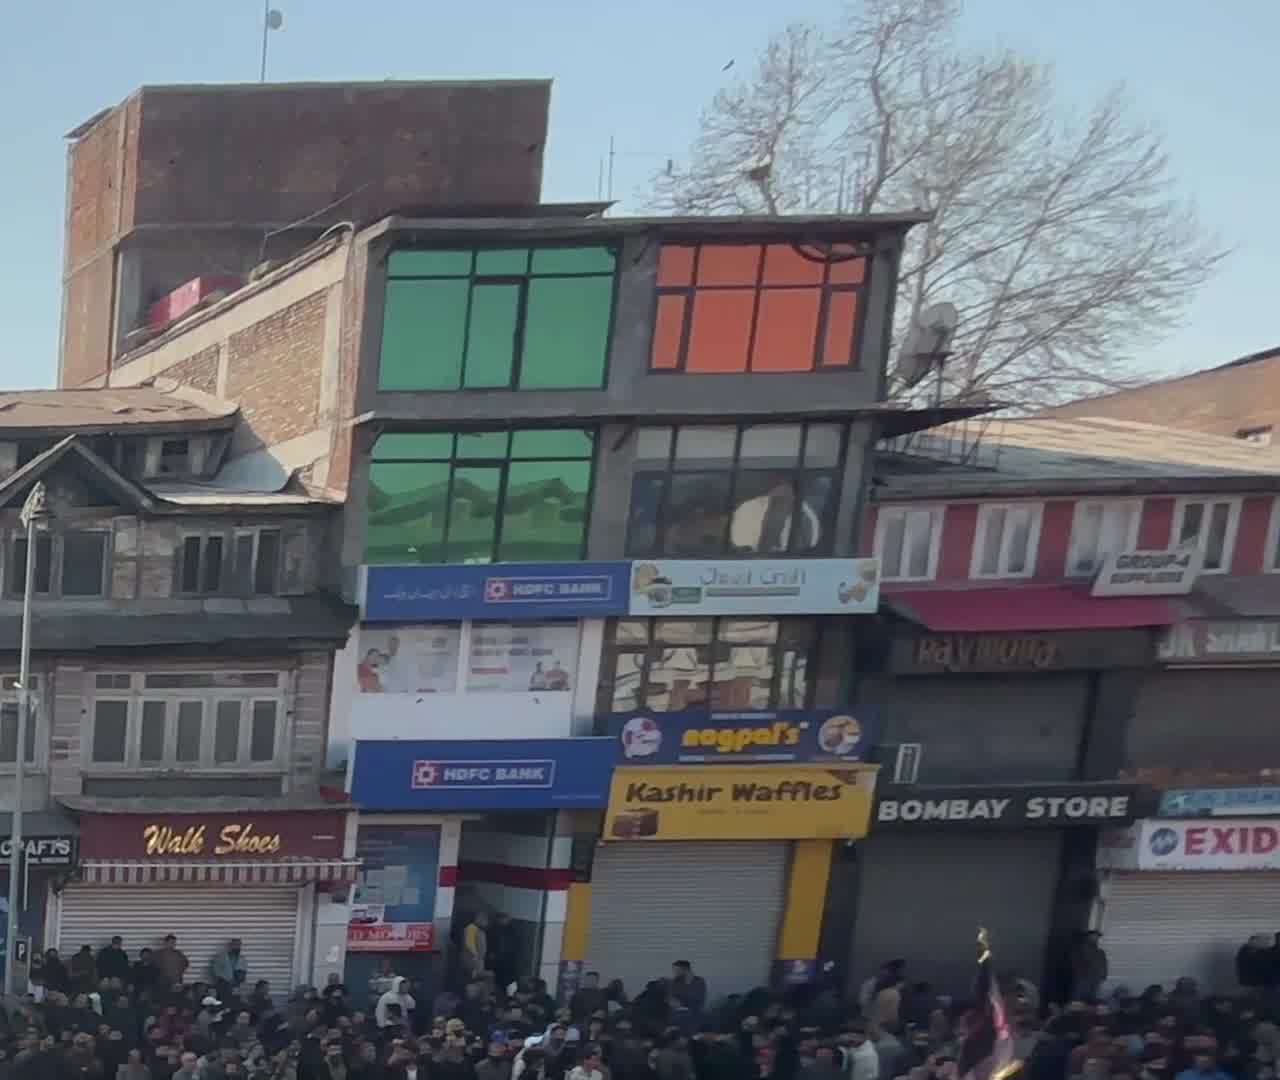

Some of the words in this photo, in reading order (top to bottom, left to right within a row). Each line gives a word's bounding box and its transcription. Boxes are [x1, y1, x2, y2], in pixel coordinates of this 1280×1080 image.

[513, 583, 554, 596] HDFC
[559, 582, 601, 595] BANK
[443, 767, 490, 781] HDFC
[495, 767, 545, 780] BANK
[625, 782, 724, 803] Kashir
[731, 780, 844, 802] Waffles
[877, 797, 1012, 822] BOMBAY
[1025, 796, 1129, 819] STORE
[143, 824, 206, 855] Walk
[214, 824, 281, 855] Shoes
